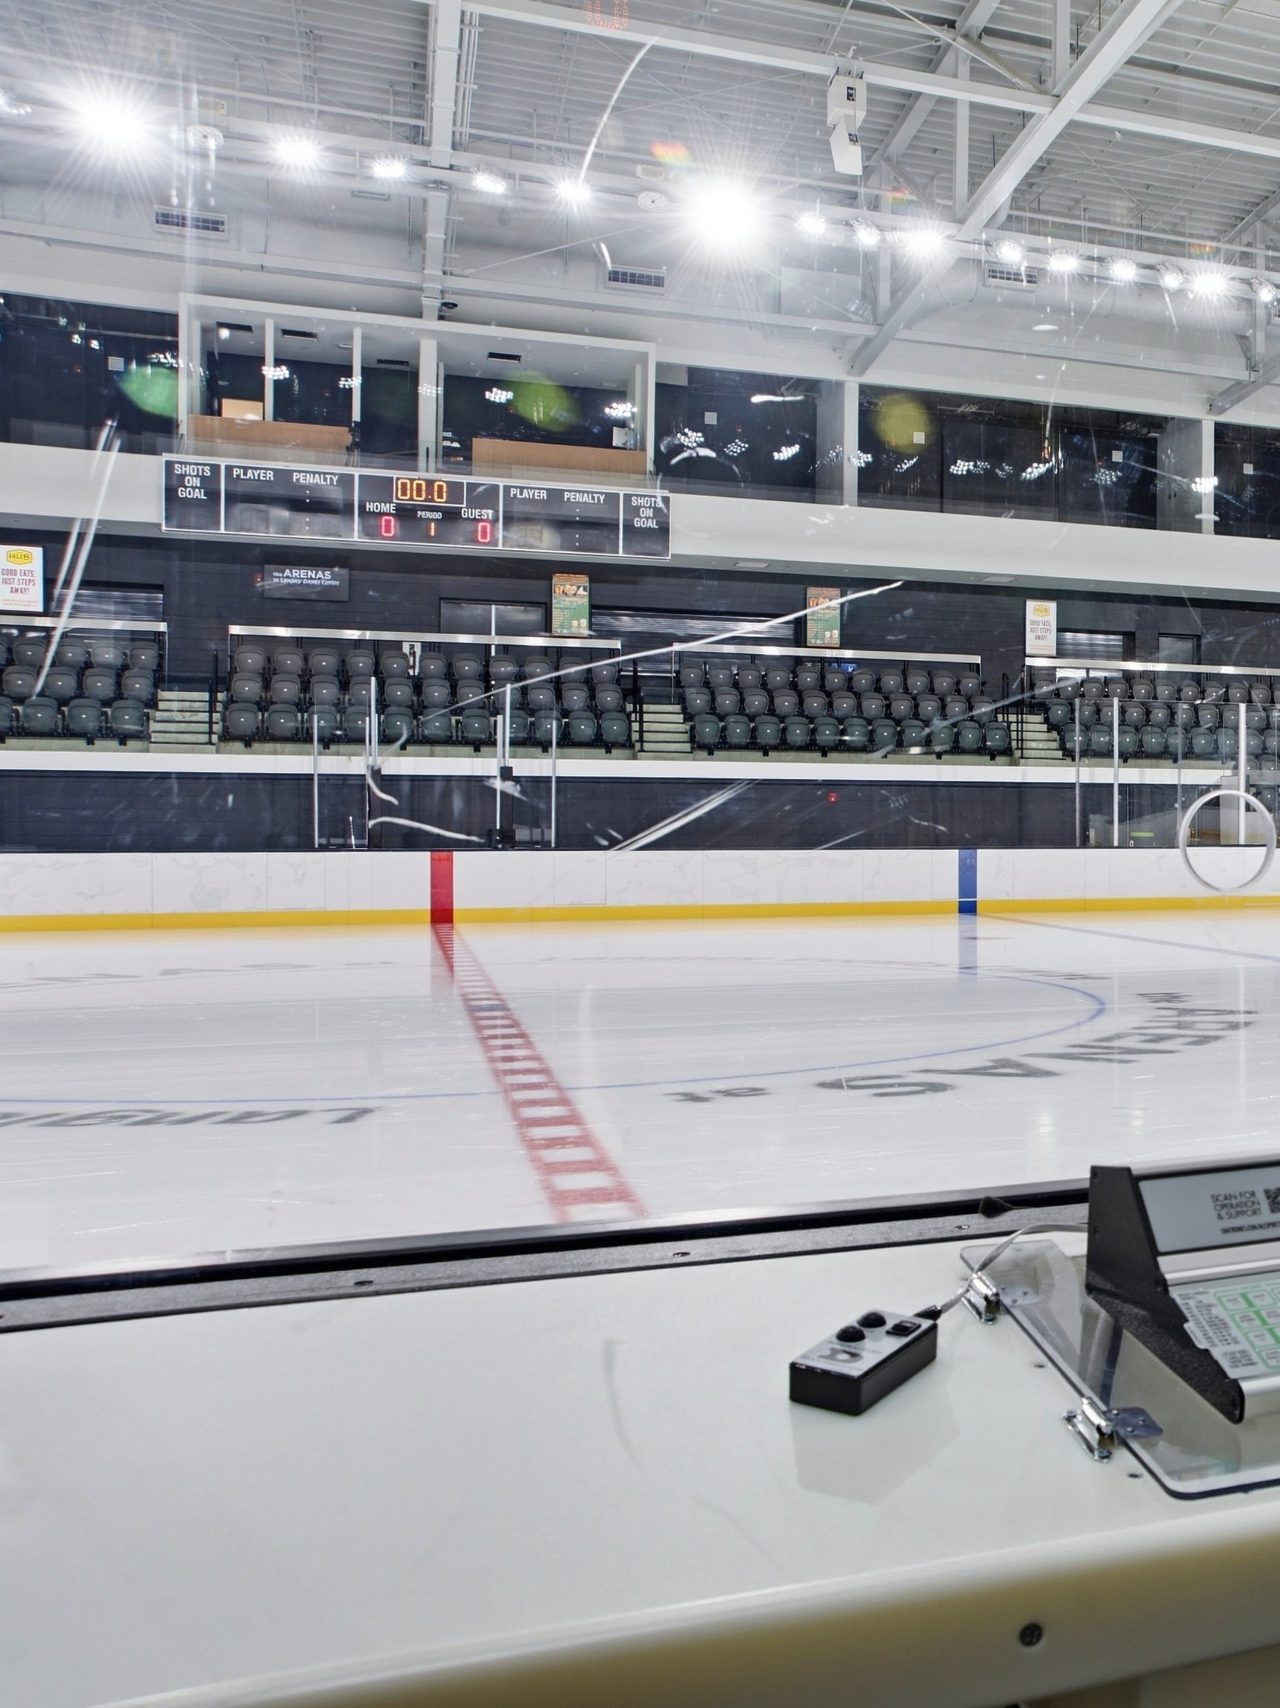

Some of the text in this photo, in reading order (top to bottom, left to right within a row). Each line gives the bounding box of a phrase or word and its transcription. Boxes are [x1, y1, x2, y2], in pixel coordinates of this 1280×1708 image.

[174, 463, 211, 477] SHOTS
[184, 476, 201, 487] ON
[233, 468, 339, 486] PLAYER PENALTY
[178, 487, 207, 500] GOAL
[397, 478, 447, 503] 00.0
[510, 488, 606, 504] PLAYER PENALTY
[365, 501, 397, 514] HOME
[631, 496, 662, 508] SHOTS
[417, 510, 443, 520] PERIOD
[461, 508, 495, 520] GUEST
[639, 507, 654, 517] ON
[381, 515, 395, 537] 0
[429, 522, 436, 537] 1
[634, 518, 659, 529] GOAL
[477, 522, 491, 543] 0
[1, 568, 17, 576] GOOD
[283, 568, 332, 580] ARENAS
[2, 577, 36, 586] JUST STEPS
[814, 1006, 1259, 1097] ARENAS
[1238, 1189, 1257, 1200] FOR
